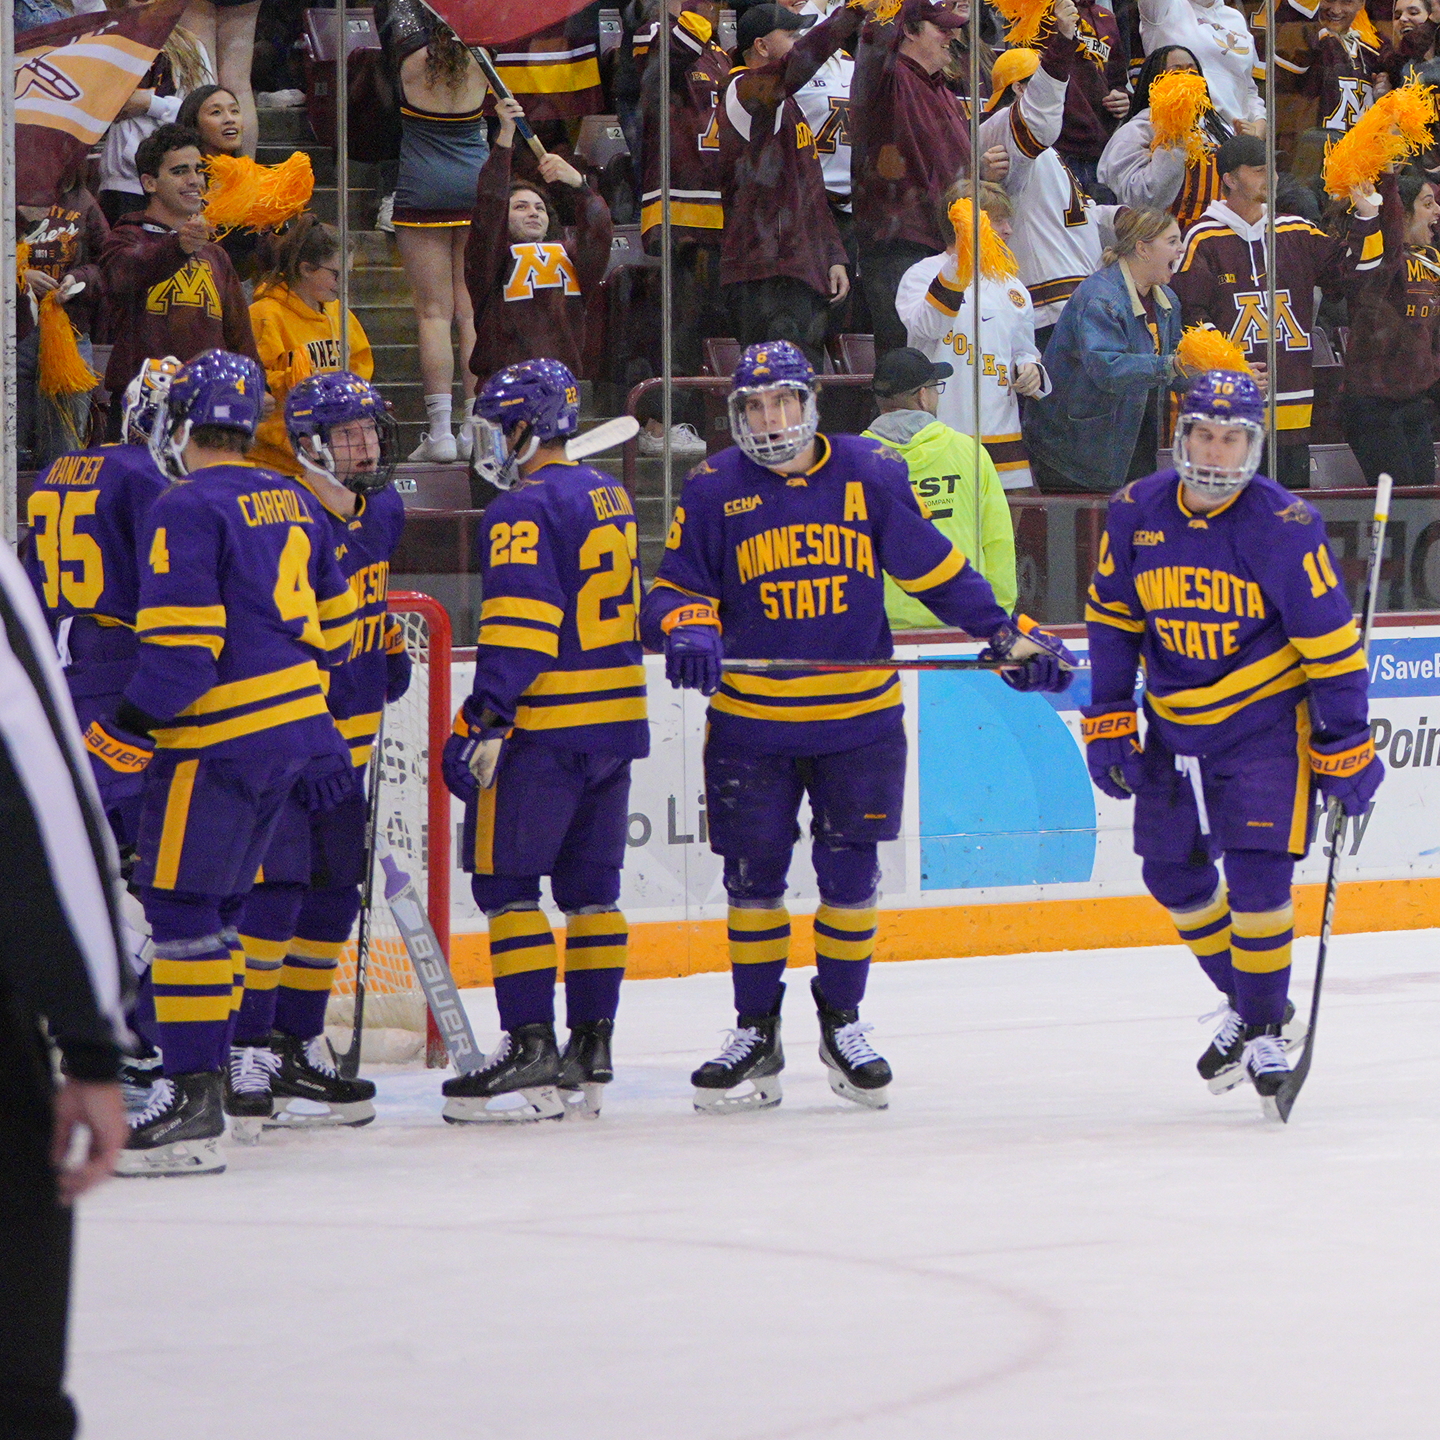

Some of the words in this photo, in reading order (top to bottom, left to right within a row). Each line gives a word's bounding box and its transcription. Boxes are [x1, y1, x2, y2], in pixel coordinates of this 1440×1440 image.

[146, 259, 223, 320] M
[504, 242, 581, 302] M
[1232, 289, 1312, 351] M
[757, 353, 767, 364] 6
[235, 379, 246, 394] 4
[565, 387, 578, 404] 22
[47, 456, 104, 485] RANCIER
[400, 480, 412, 491] 17
[724, 495, 763, 516] CCHA
[843, 481, 869, 521] A
[149, 528, 170, 574] 4
[490, 520, 539, 567] 22
[736, 523, 875, 584] MINNESOTA
[274, 526, 326, 650] 4
[760, 575, 848, 620] STATE
[1134, 565, 1265, 620] MINNESOTA
[1155, 617, 1241, 661] STATE
[407, 933, 473, 1057] BAUER
